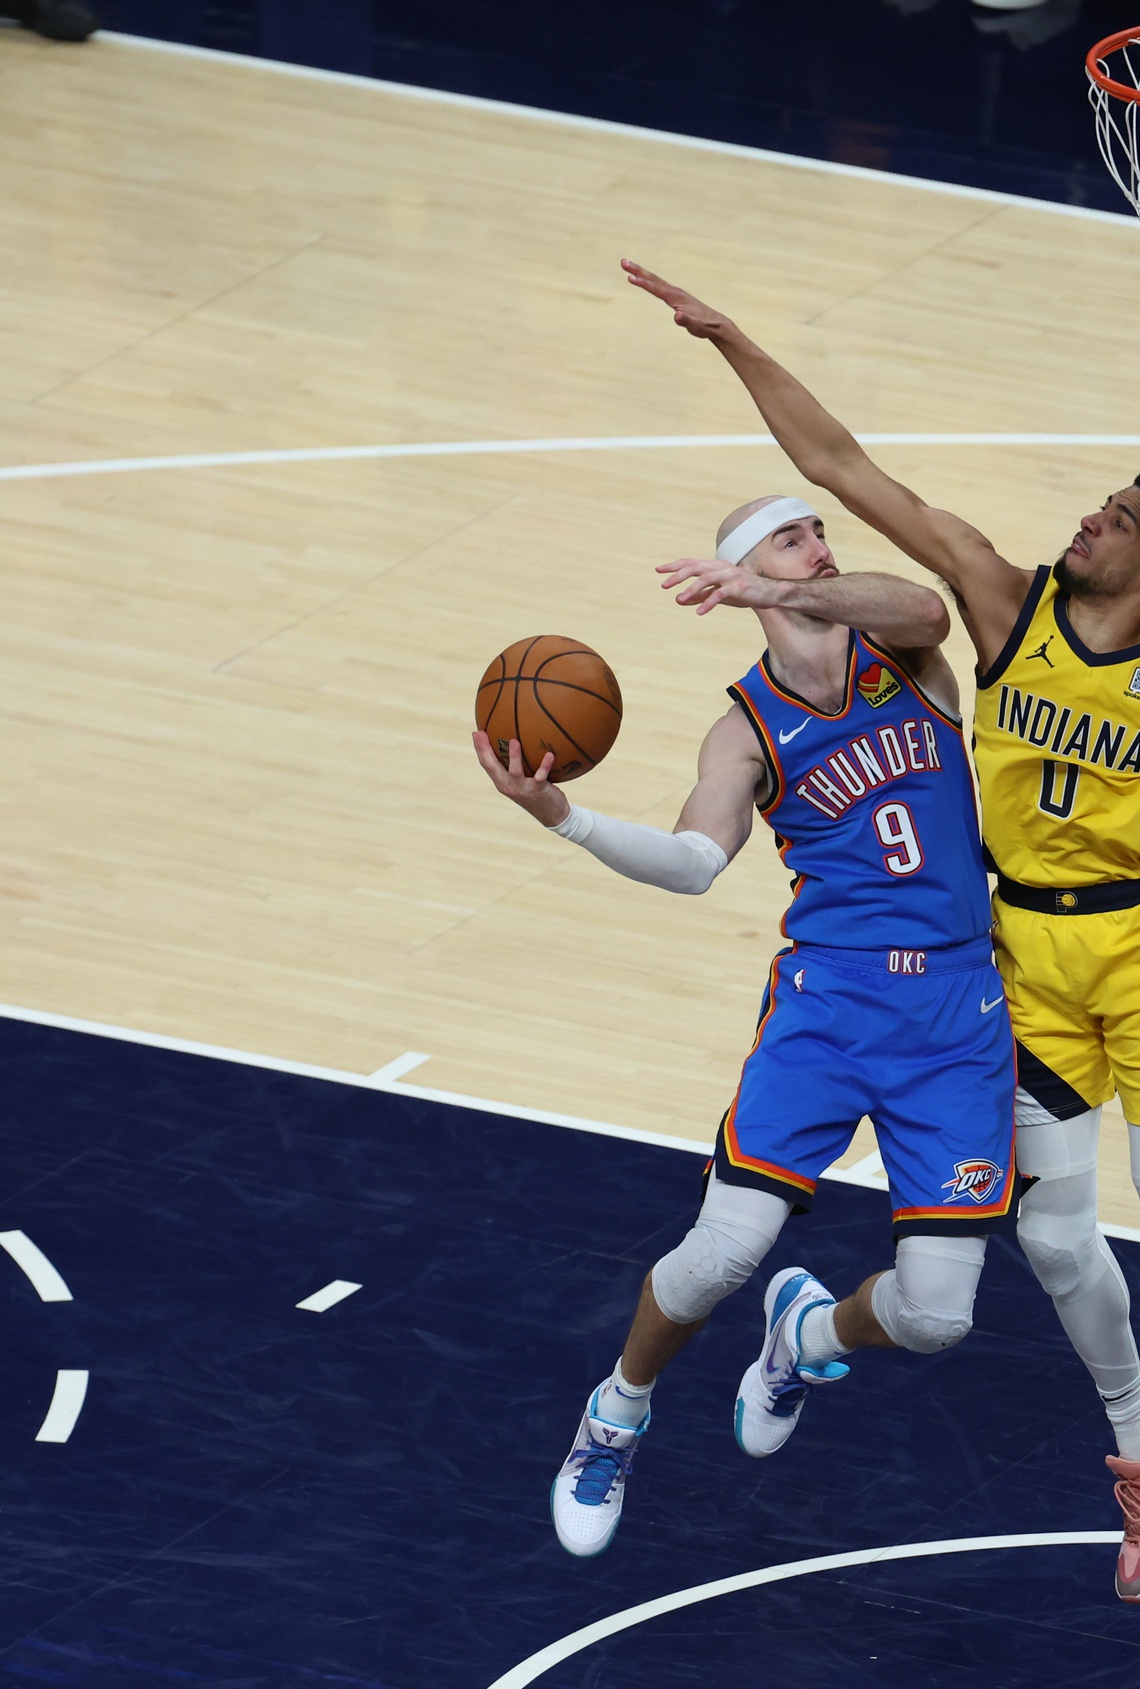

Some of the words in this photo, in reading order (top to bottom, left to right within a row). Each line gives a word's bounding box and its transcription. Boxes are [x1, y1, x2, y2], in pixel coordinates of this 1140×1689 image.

[795, 717, 943, 822] THUNDER
[872, 800, 925, 878] 9
[887, 949, 927, 975] OKC
[956, 1168, 992, 1193] OKC
